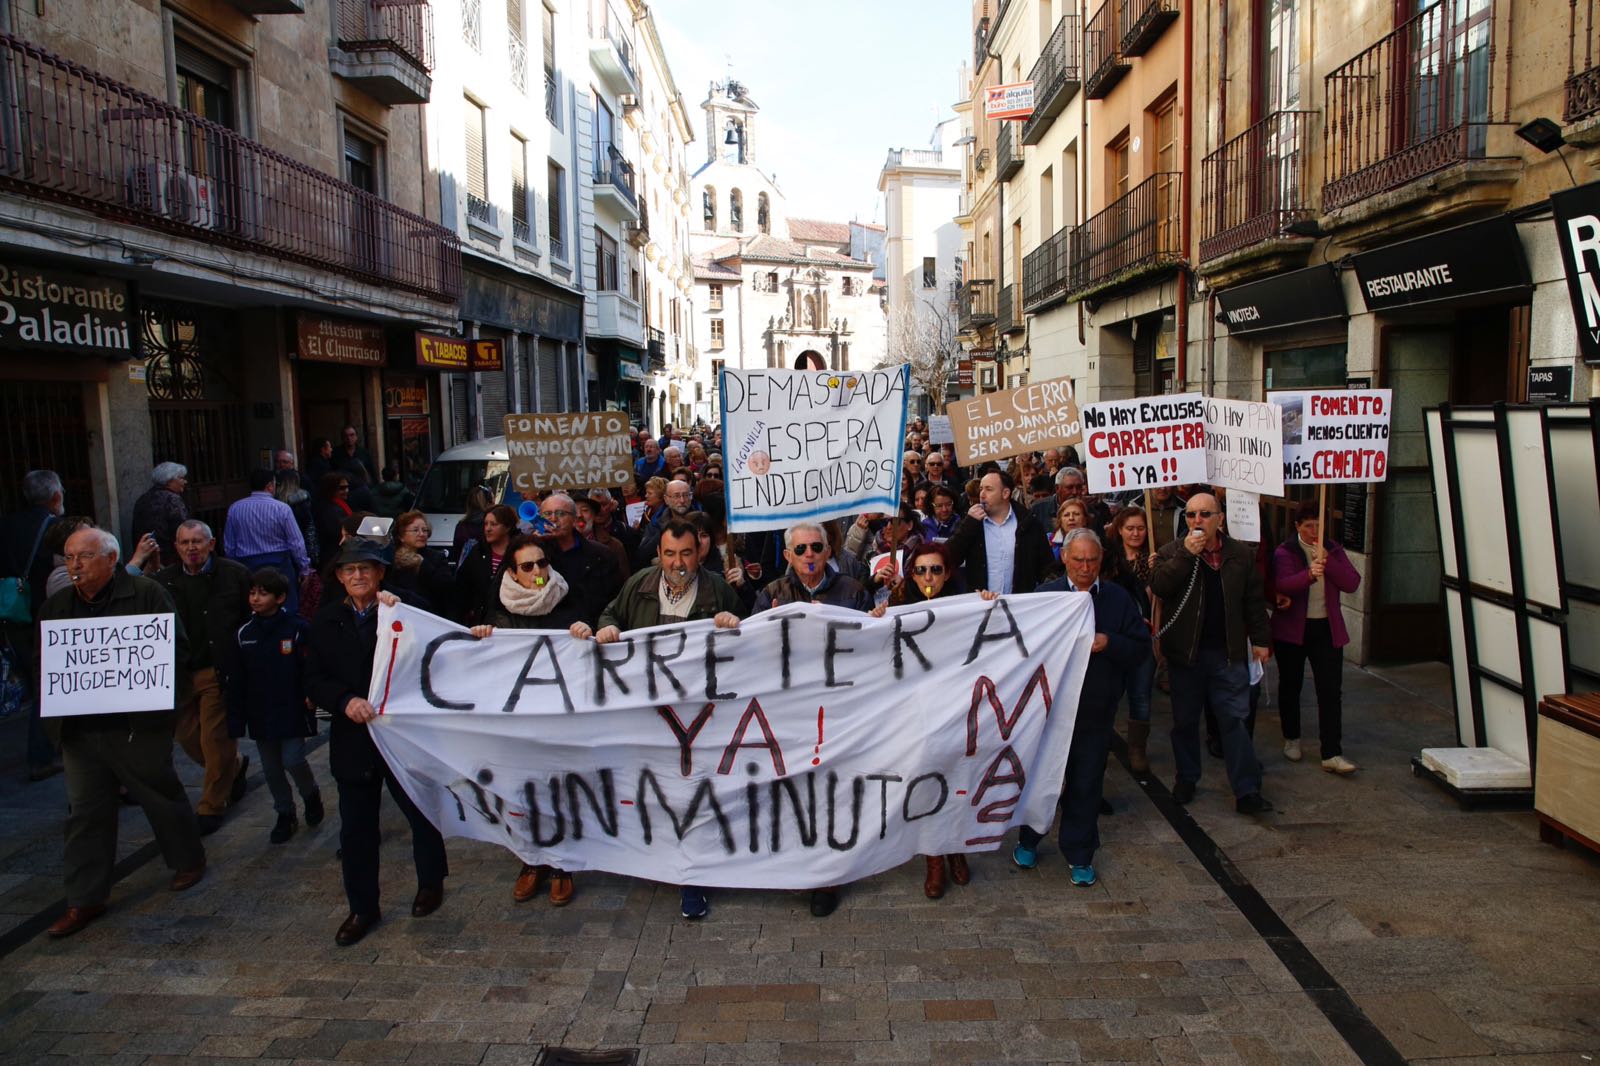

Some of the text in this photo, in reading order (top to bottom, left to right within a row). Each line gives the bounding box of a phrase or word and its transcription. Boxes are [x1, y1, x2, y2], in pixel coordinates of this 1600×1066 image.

[0, 264, 125, 312] Ristorante
[1366, 263, 1453, 298] RESTAURANTE
[0, 300, 130, 349] Paladini
[1227, 306, 1260, 324] VINOTECA
[319, 319, 363, 340] Mesón
[307, 335, 380, 361] El Churrasco
[434, 341, 467, 361] TABACOS
[722, 368, 907, 413] DEMASIADA
[1531, 372, 1553, 383] TAPAS
[966, 380, 1073, 421] EL CERRO
[1109, 407, 1137, 426] HAY
[1140, 400, 1204, 424] EXCUSAS
[508, 415, 622, 436] FOMENTO
[1016, 405, 1069, 430] JAMAS
[1223, 406, 1244, 428] HAY
[1248, 403, 1276, 431] PAN
[767, 416, 882, 462] ESPERA
[1088, 422, 1206, 459] CARRETERA
[1204, 430, 1272, 458] PARA TANTO
[1307, 423, 1389, 441] MENOS CUENTO
[968, 437, 1012, 460] SERA
[534, 456, 546, 472] Y
[1283, 448, 1386, 480] MÁS CEMENTO
[515, 470, 630, 489] CEMENTO
[732, 459, 896, 509] INDIGNADOS
[48, 616, 172, 647] DIPUTACIÓN,
[65, 645, 155, 669] NUESTRO
[48, 663, 170, 696] PUIGDEMONT.
